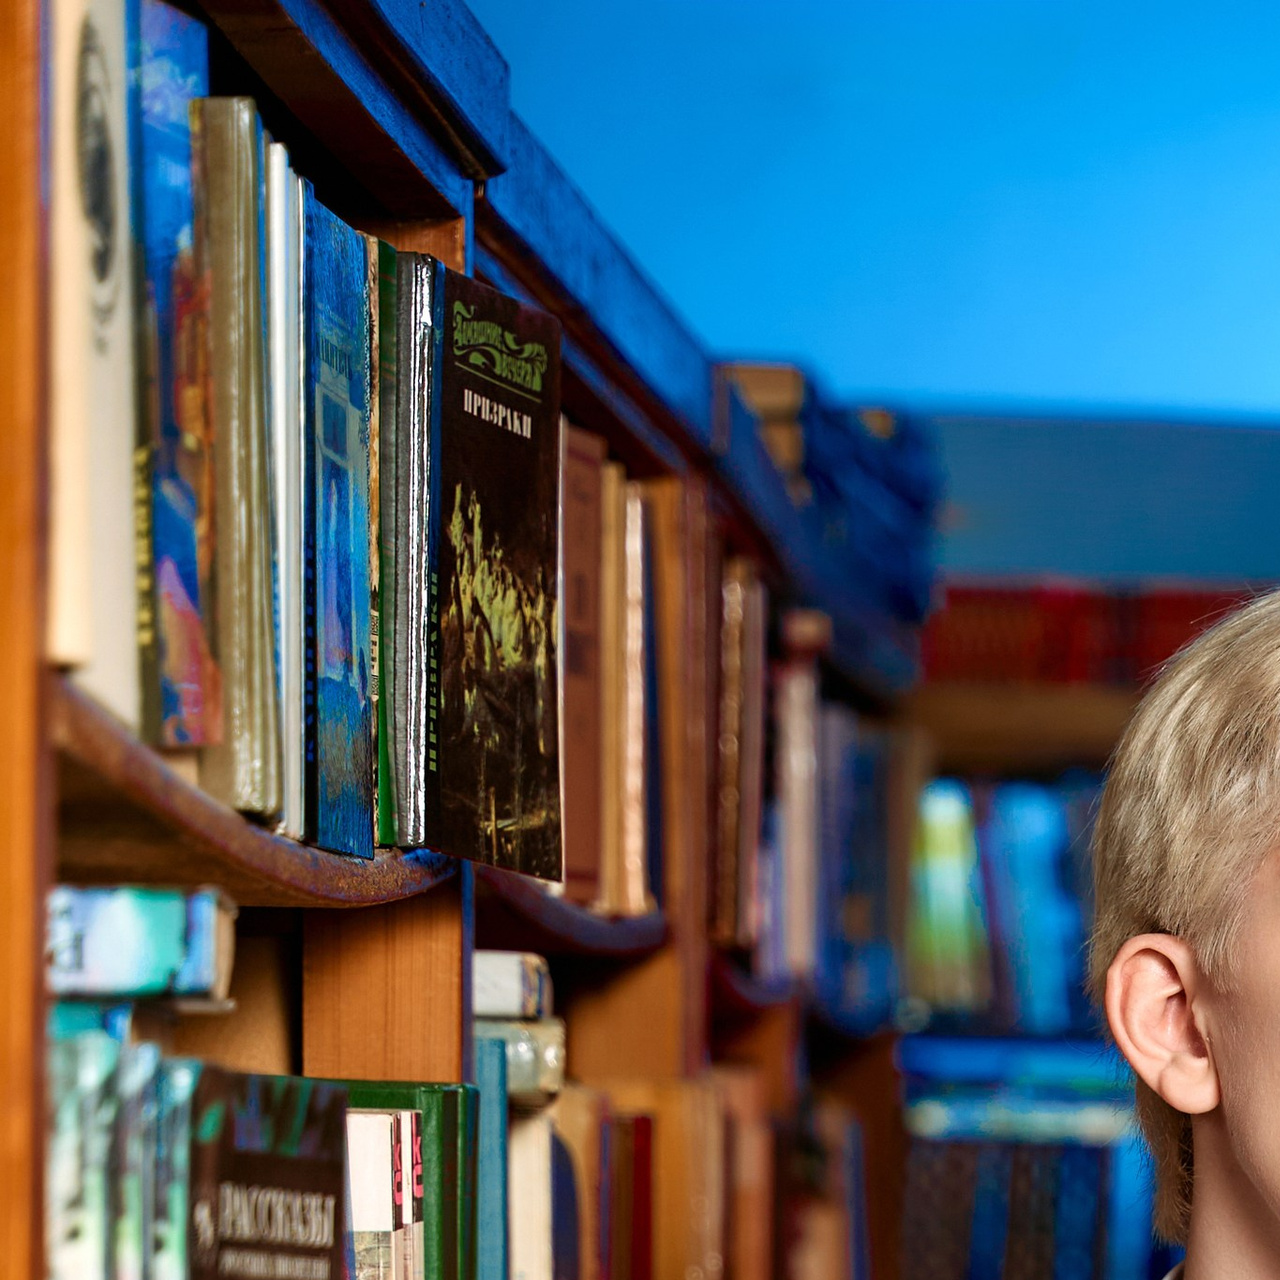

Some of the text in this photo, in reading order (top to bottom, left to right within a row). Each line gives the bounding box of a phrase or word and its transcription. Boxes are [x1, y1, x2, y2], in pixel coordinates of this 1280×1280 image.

[463, 388, 532, 439] ПРИЗРАКИ
[428, 571, 438, 772] ПРИЗРАКИ
[219, 1180, 335, 1248] РАССКАЗЫ
